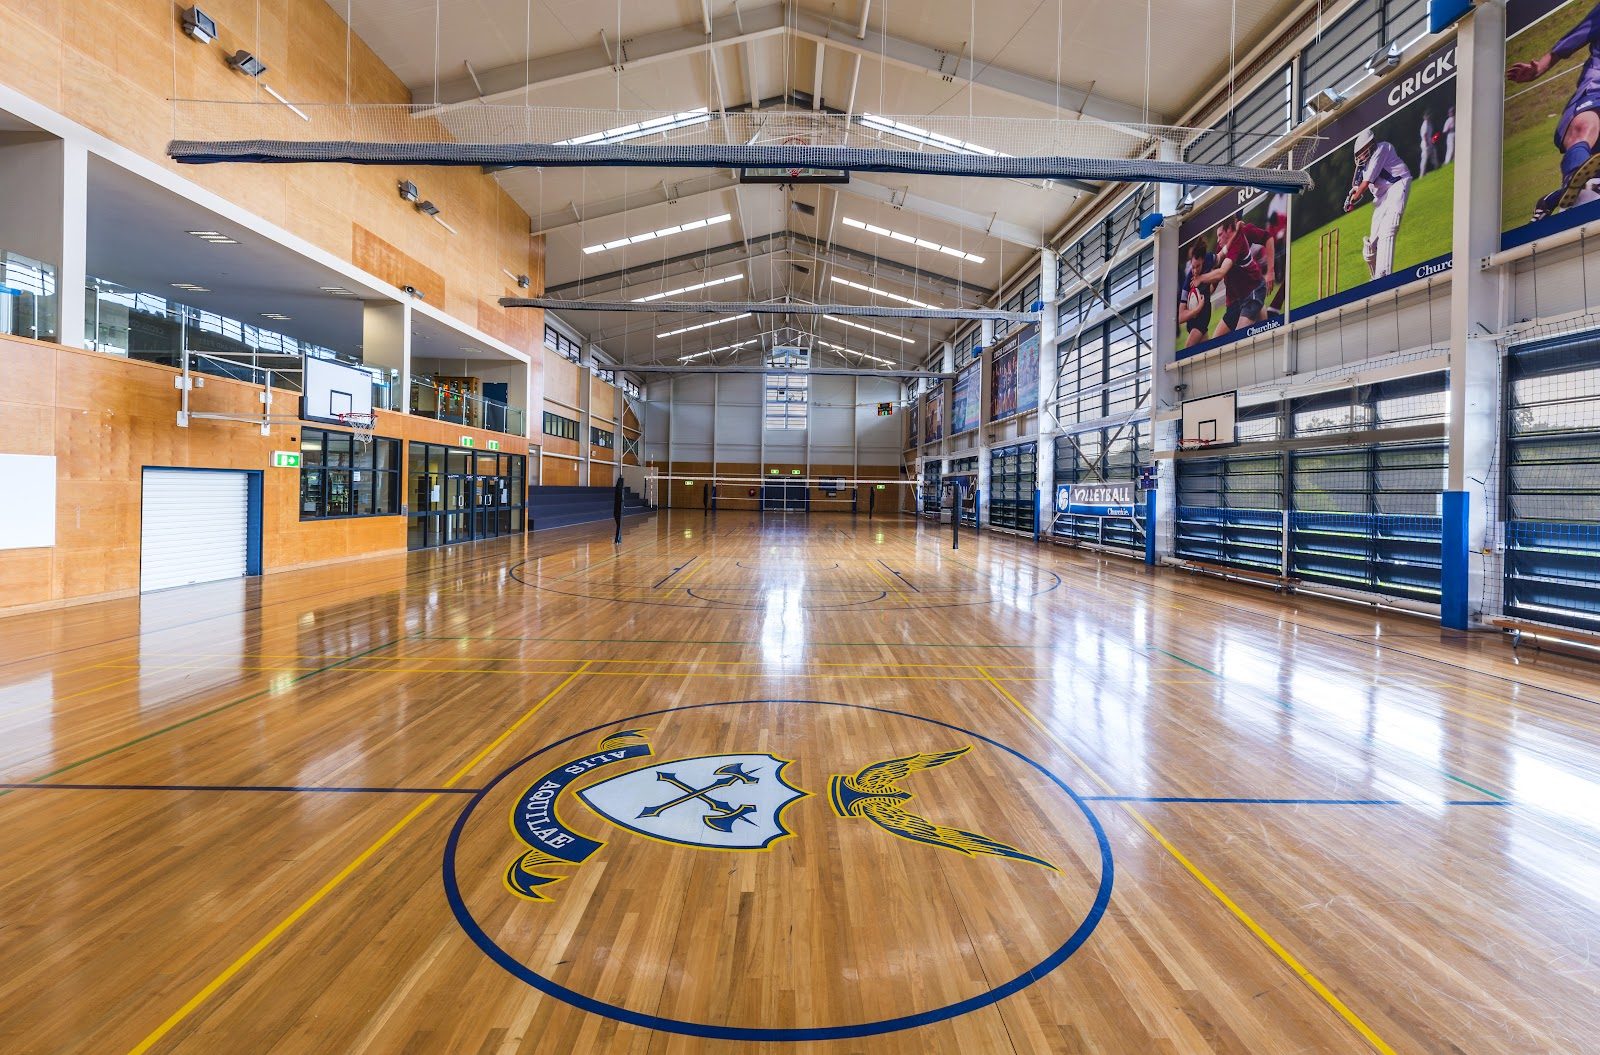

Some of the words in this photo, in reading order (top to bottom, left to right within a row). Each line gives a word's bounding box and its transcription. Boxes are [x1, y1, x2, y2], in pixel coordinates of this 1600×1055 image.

[1388, 47, 1457, 106] CRICK
[1074, 487, 1130, 502] VOLLEYBALL
[565, 750, 626, 774] ALIS
[525, 780, 575, 849] AQUILAE
